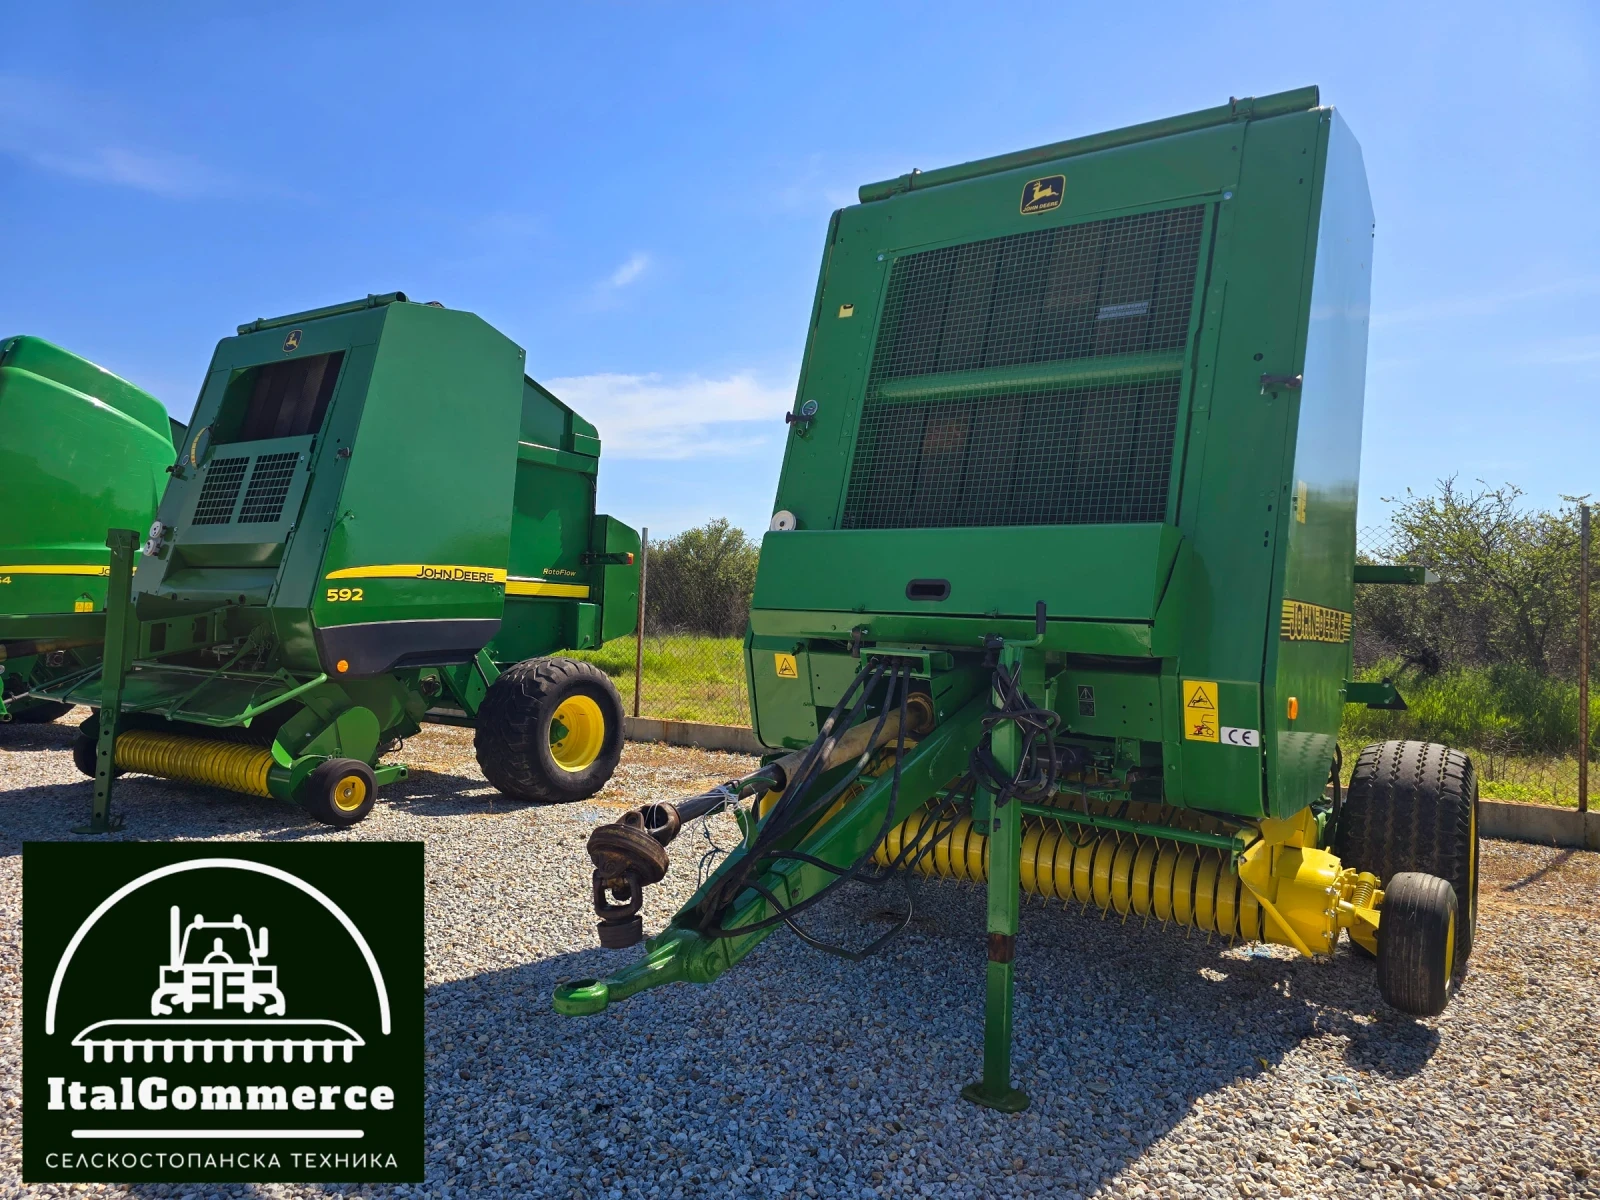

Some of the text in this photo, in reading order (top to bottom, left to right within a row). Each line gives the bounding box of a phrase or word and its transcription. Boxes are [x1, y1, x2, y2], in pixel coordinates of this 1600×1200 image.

[1039, 200, 1059, 209] DEERE
[416, 565, 495, 582] JOHN DEERE
[542, 567, 577, 577] RotoFlow
[326, 588, 364, 602] 592
[1289, 603, 1345, 641] JOHN DEERE
[1228, 729, 1252, 746] CE
